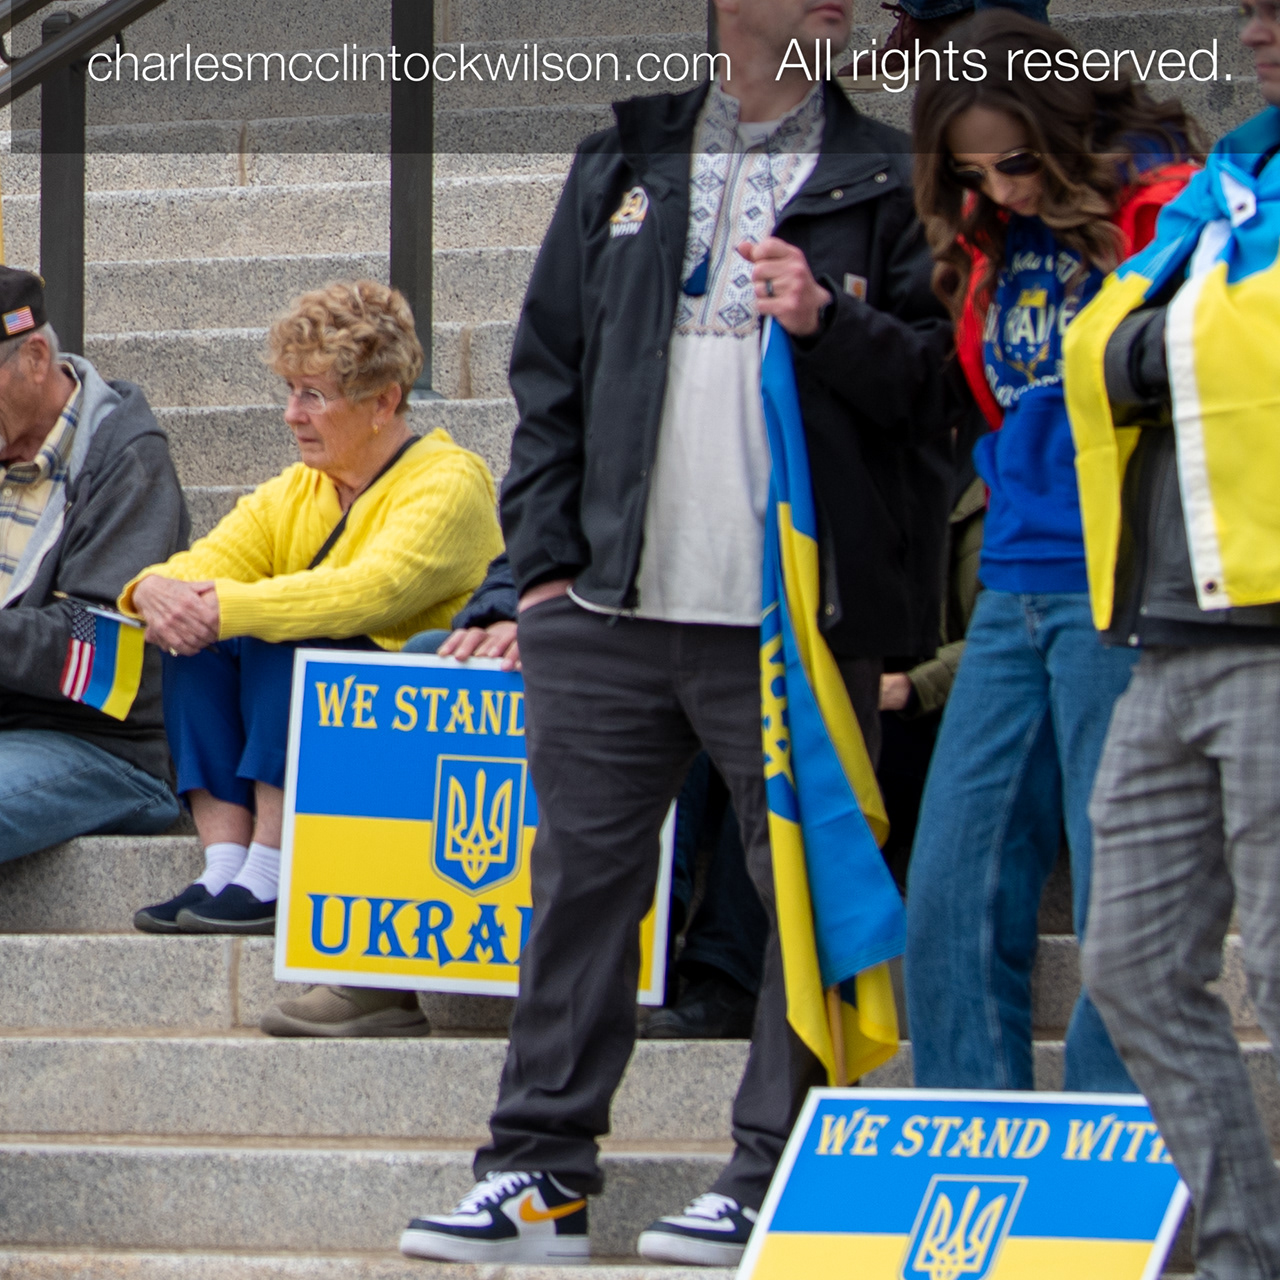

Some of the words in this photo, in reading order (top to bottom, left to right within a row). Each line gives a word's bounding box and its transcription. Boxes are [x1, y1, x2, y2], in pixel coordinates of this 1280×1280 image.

[315, 674, 380, 729] WE
[392, 685, 526, 736] STAND
[307, 893, 534, 968] UKRAI
[815, 1107, 890, 1157] WE
[892, 1114, 1051, 1159] STAND
